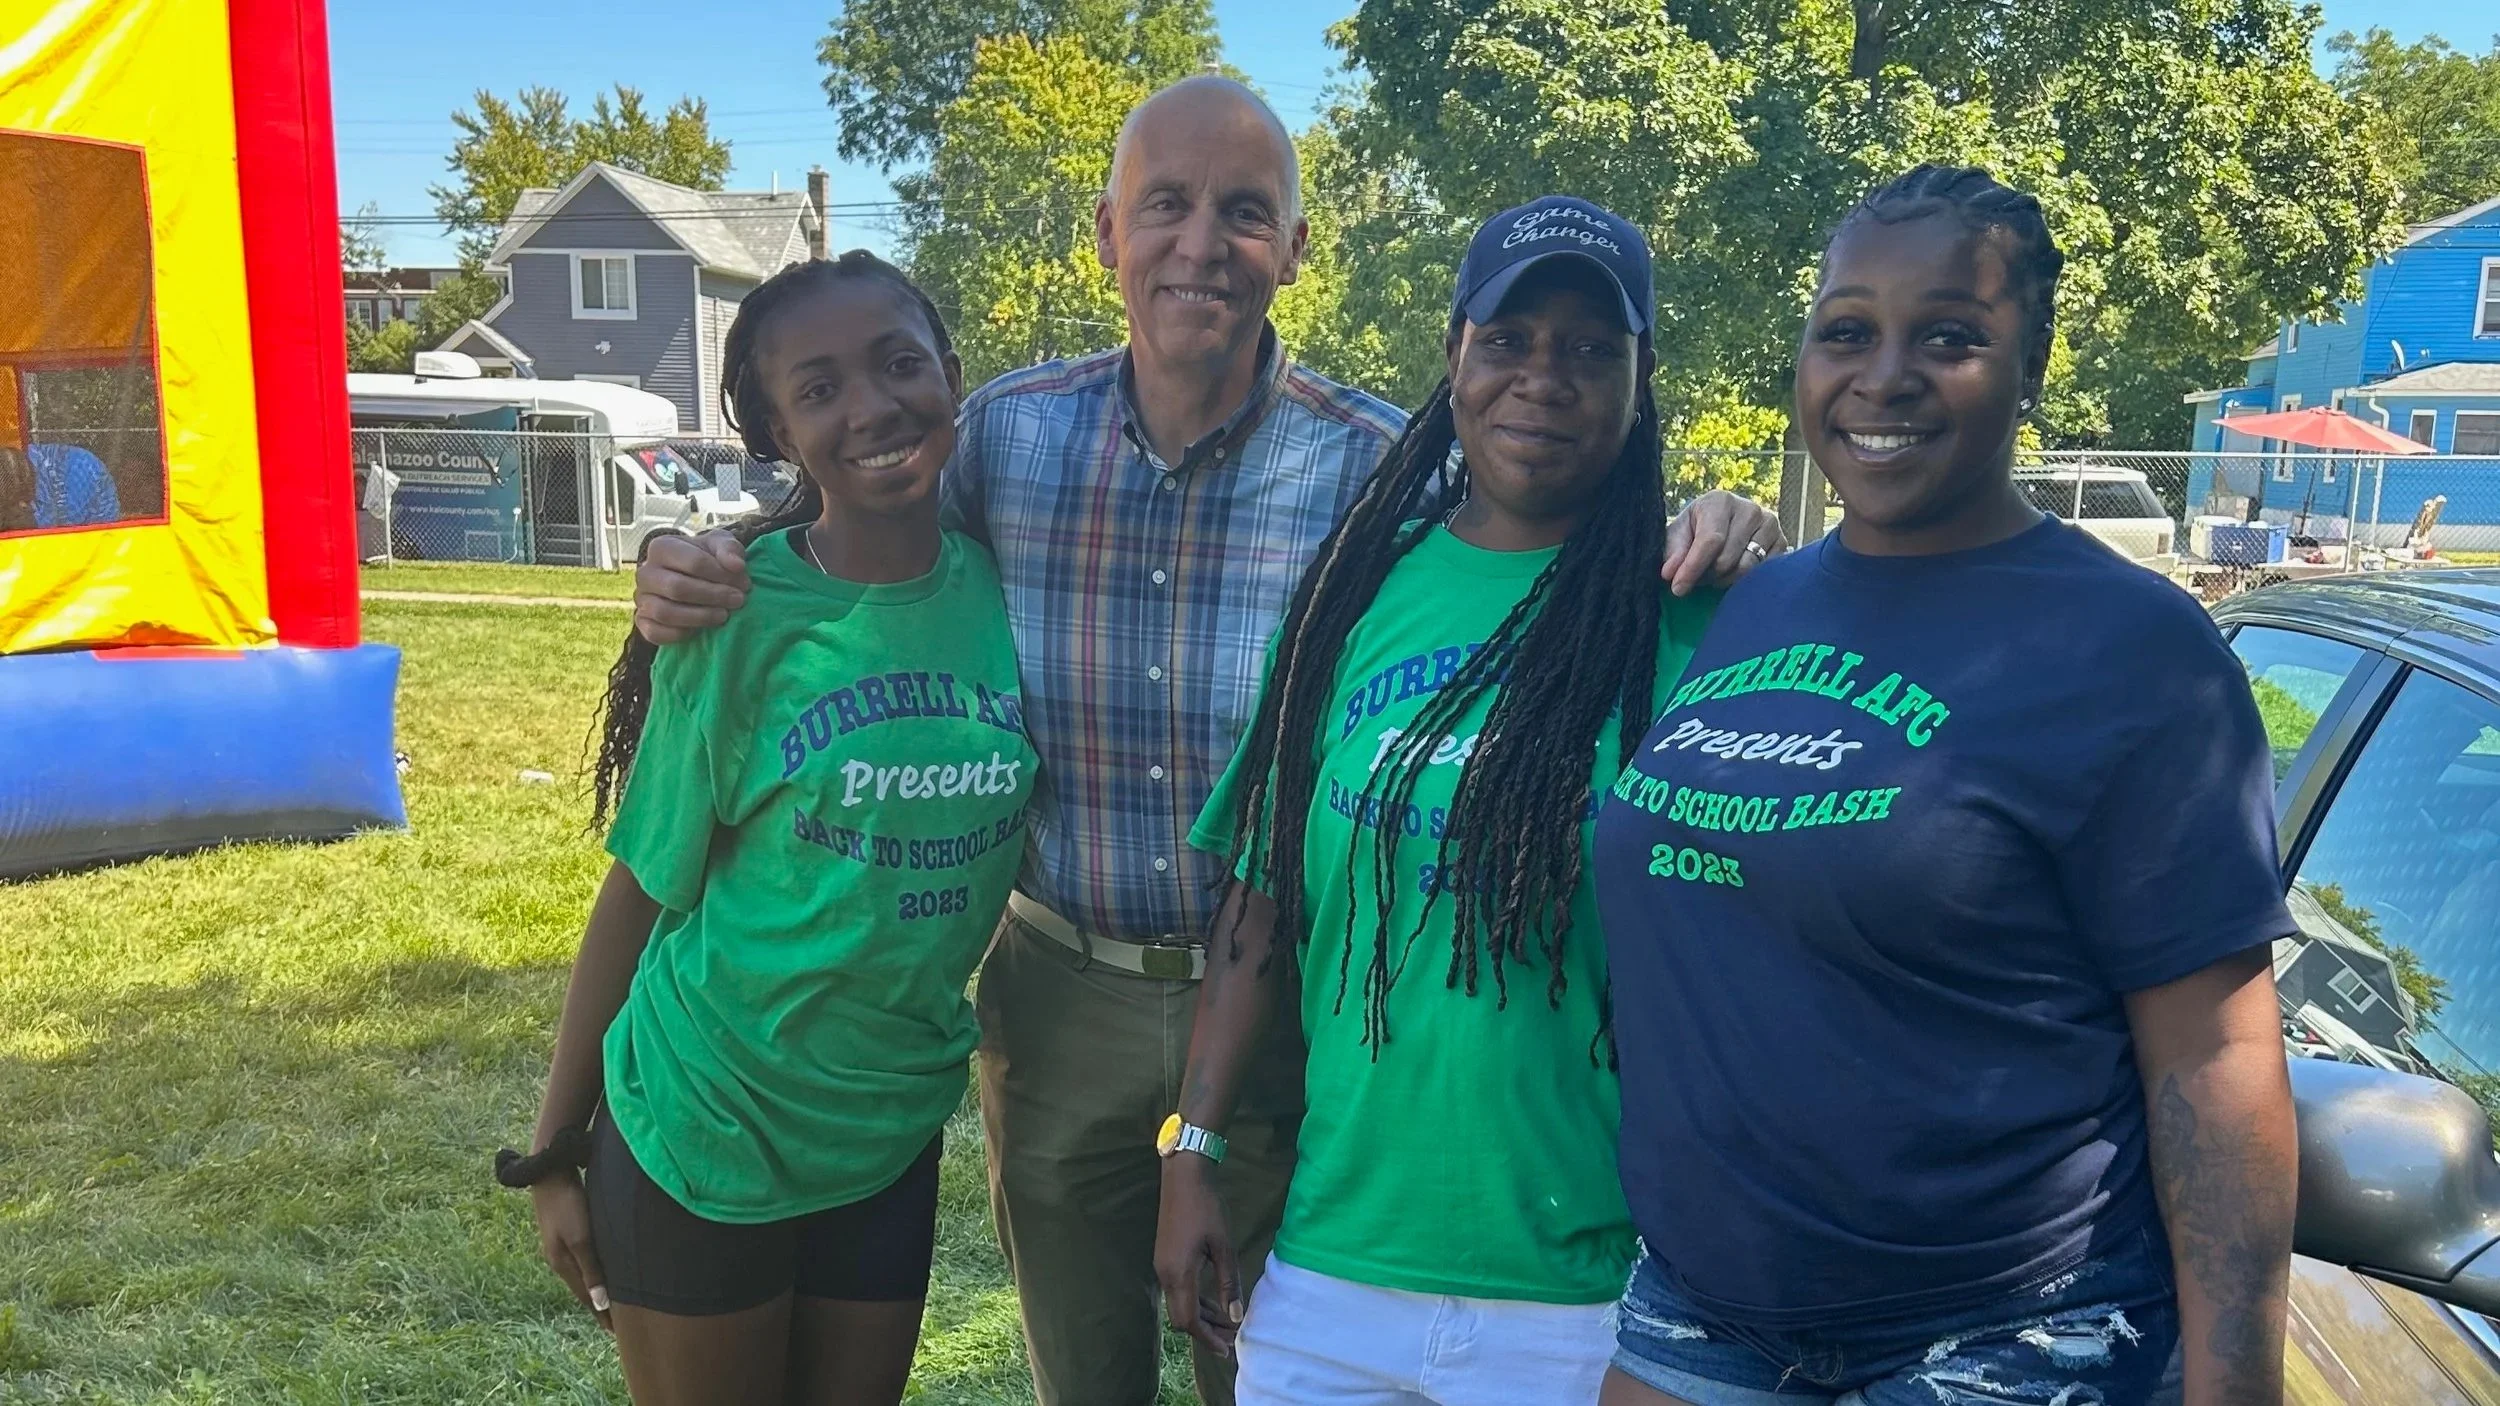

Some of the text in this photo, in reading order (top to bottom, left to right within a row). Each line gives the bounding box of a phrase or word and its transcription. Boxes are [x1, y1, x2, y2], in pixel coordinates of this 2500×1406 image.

[1502, 225, 1621, 256] Changer
[1512, 207, 1612, 232] Game
[353, 446, 434, 467] alamazoo
[1654, 643, 1951, 748] BURRELL AFC
[780, 671, 1026, 780] BURRELL AF
[1652, 717, 1864, 770] Presents
[840, 751, 1022, 807] Presents
[1633, 775, 1670, 814] TO
[1668, 786, 1781, 833] SCHOOL
[1781, 787, 1902, 831] BASH
[793, 806, 868, 864] BACK
[871, 835, 903, 869] TO
[909, 824, 990, 871] SCHOOL
[1648, 843, 1745, 887] 2023
[898, 886, 970, 921] 2023
